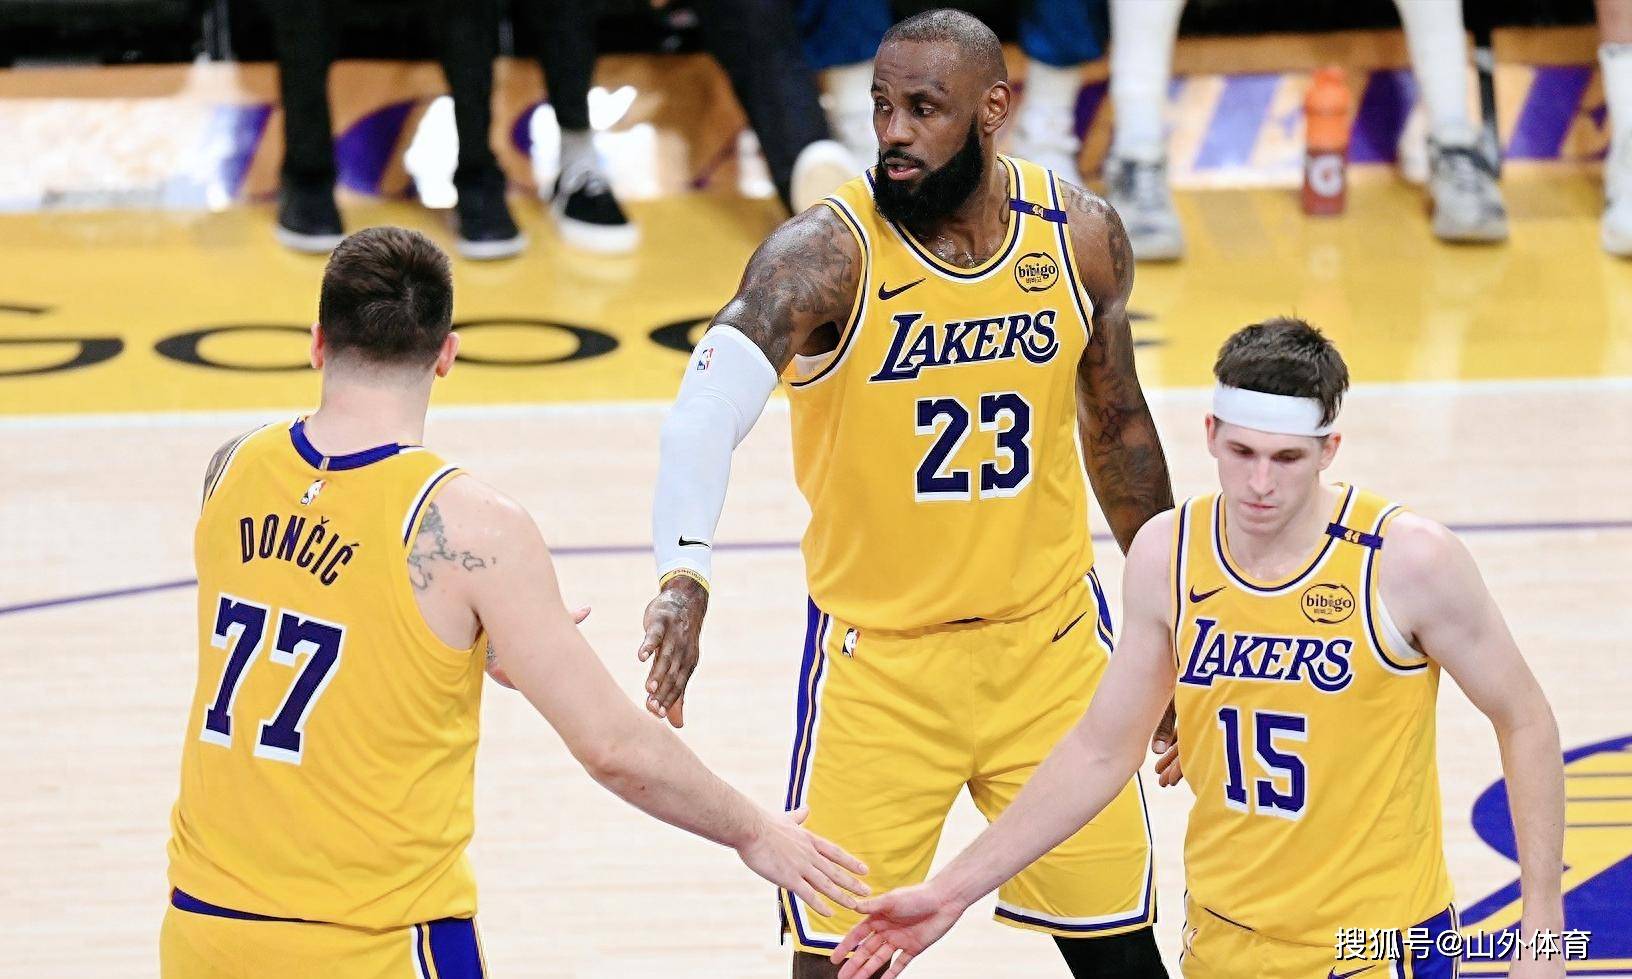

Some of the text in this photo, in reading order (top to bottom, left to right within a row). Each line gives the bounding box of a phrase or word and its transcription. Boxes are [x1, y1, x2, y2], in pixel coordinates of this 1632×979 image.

[1018, 263, 1056, 279] bibigo
[868, 310, 1060, 383] LAKERS
[915, 391, 1032, 502] 23
[239, 514, 360, 587] DONČIĆ
[200, 592, 347, 766] 77
[1179, 618, 1354, 692] LAKERS
[1218, 706, 1307, 821] 15
